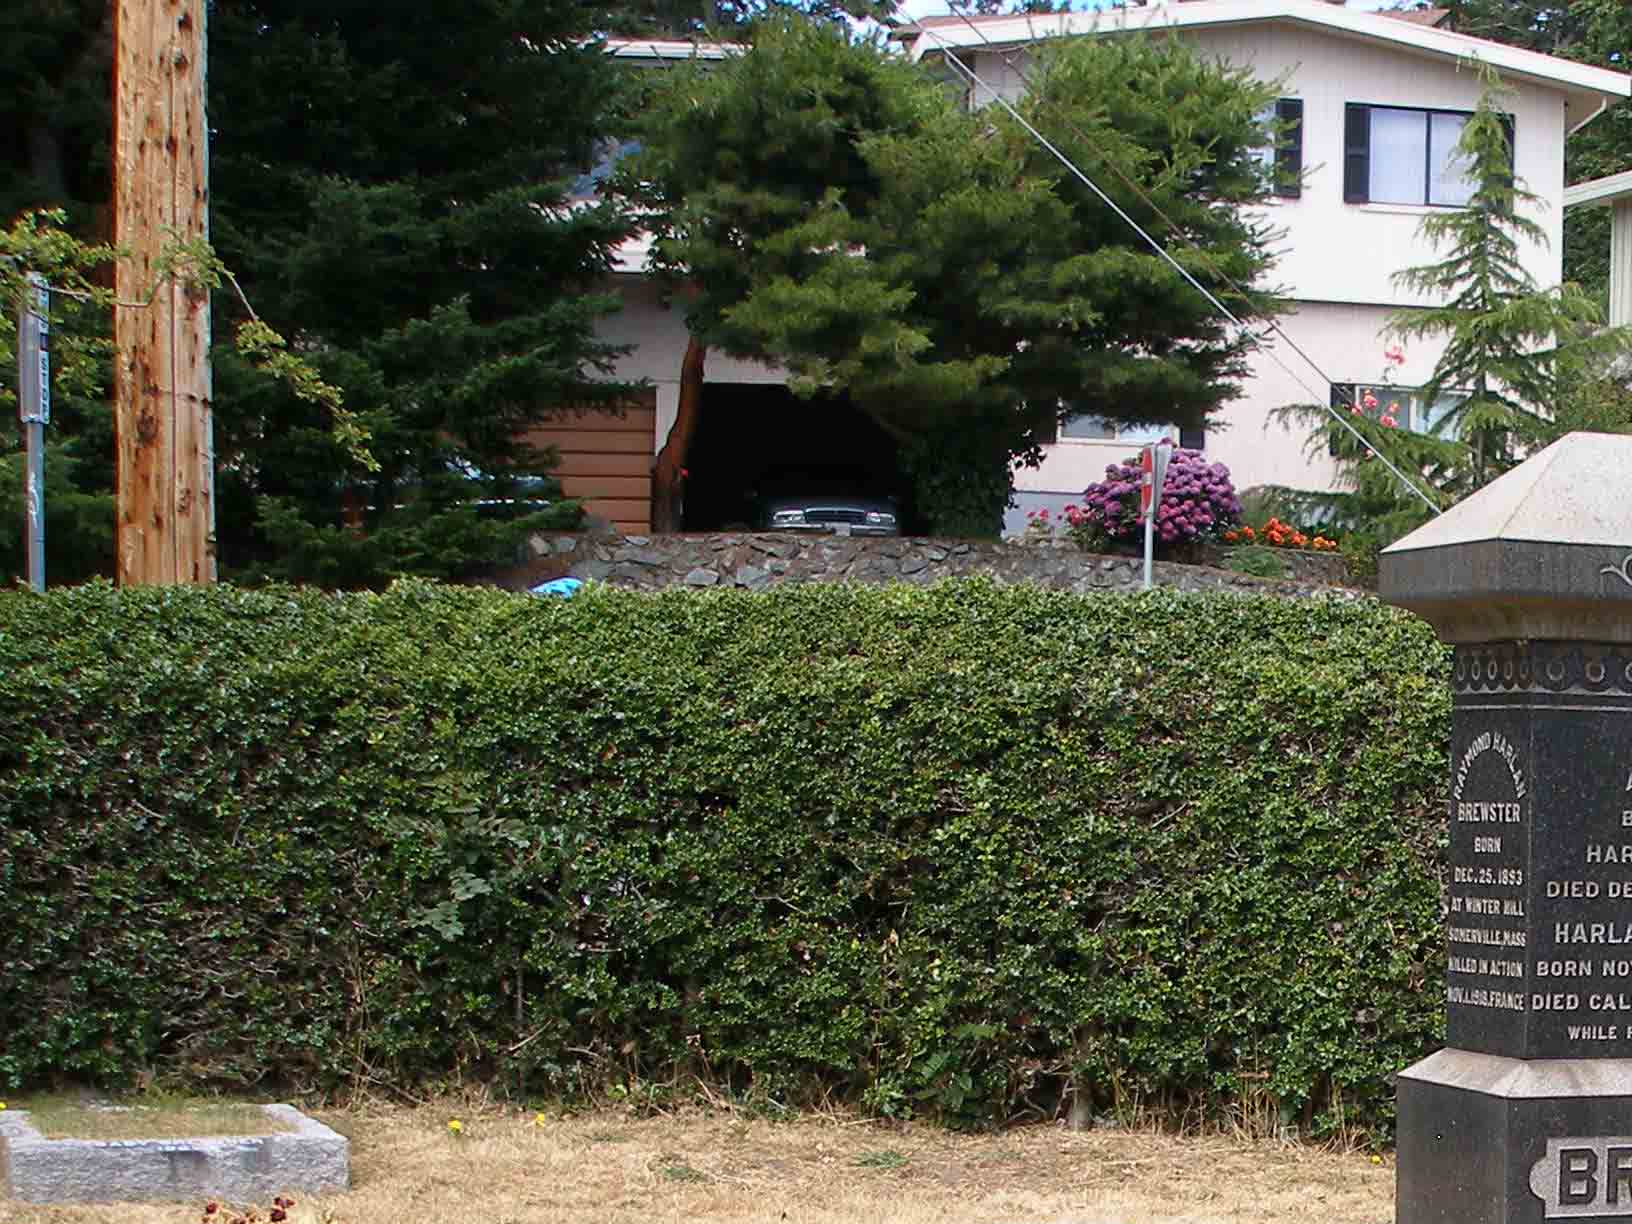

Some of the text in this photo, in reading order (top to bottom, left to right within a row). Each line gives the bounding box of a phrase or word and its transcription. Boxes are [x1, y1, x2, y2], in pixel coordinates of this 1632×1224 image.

[1453, 731, 1527, 800] RAYMOND HARLAN
[1457, 803, 1521, 823] BREWSTER
[1474, 837, 1502, 853] BORN
[1546, 881, 1599, 899] DIED
[1451, 897, 1463, 912] AT
[1489, 960, 1523, 978] ACTION
[1536, 960, 1592, 977] BORN
[1532, 993, 1580, 1010] DIED
[1567, 1024, 1617, 1041] WHILE
